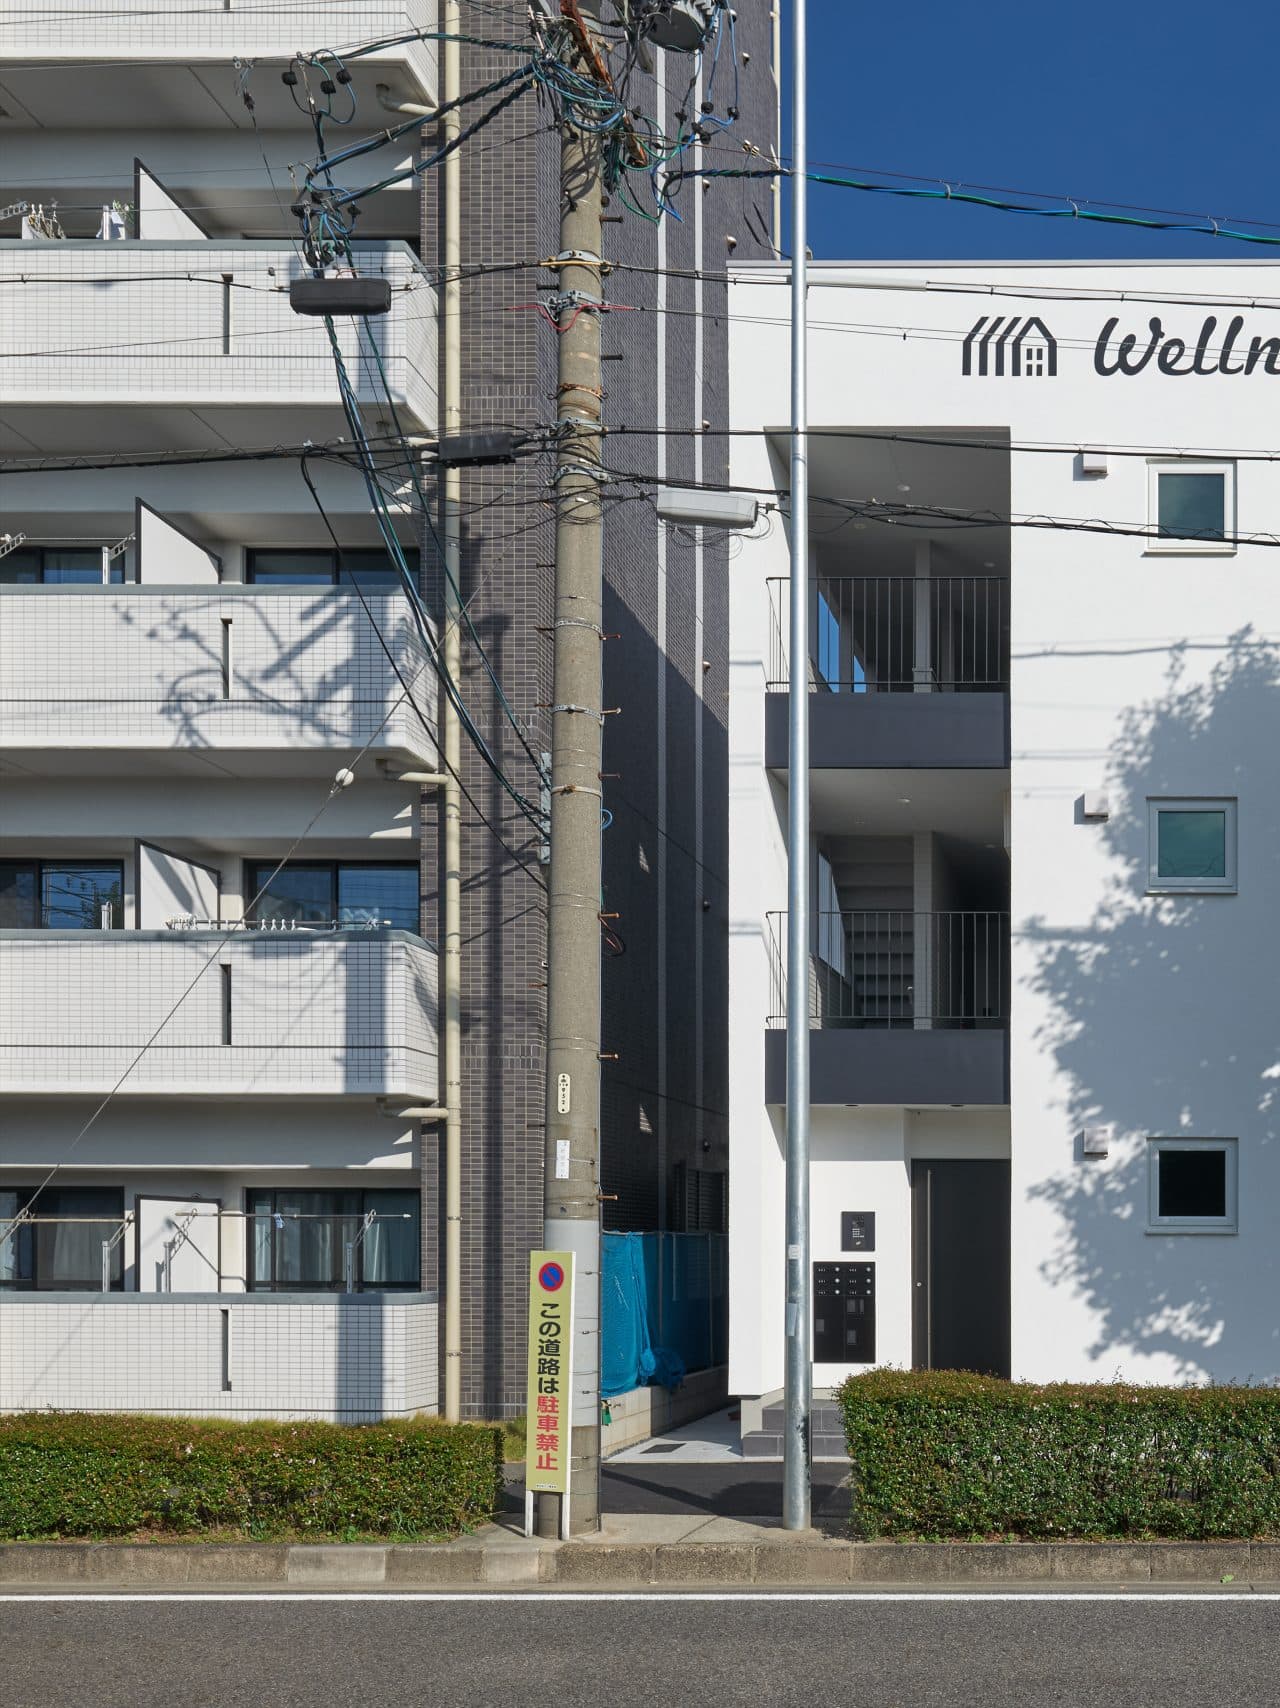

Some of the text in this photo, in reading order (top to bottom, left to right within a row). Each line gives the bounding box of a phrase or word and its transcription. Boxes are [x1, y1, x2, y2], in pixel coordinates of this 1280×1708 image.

[535, 1302, 562, 1472] この道路は駐車禁止
